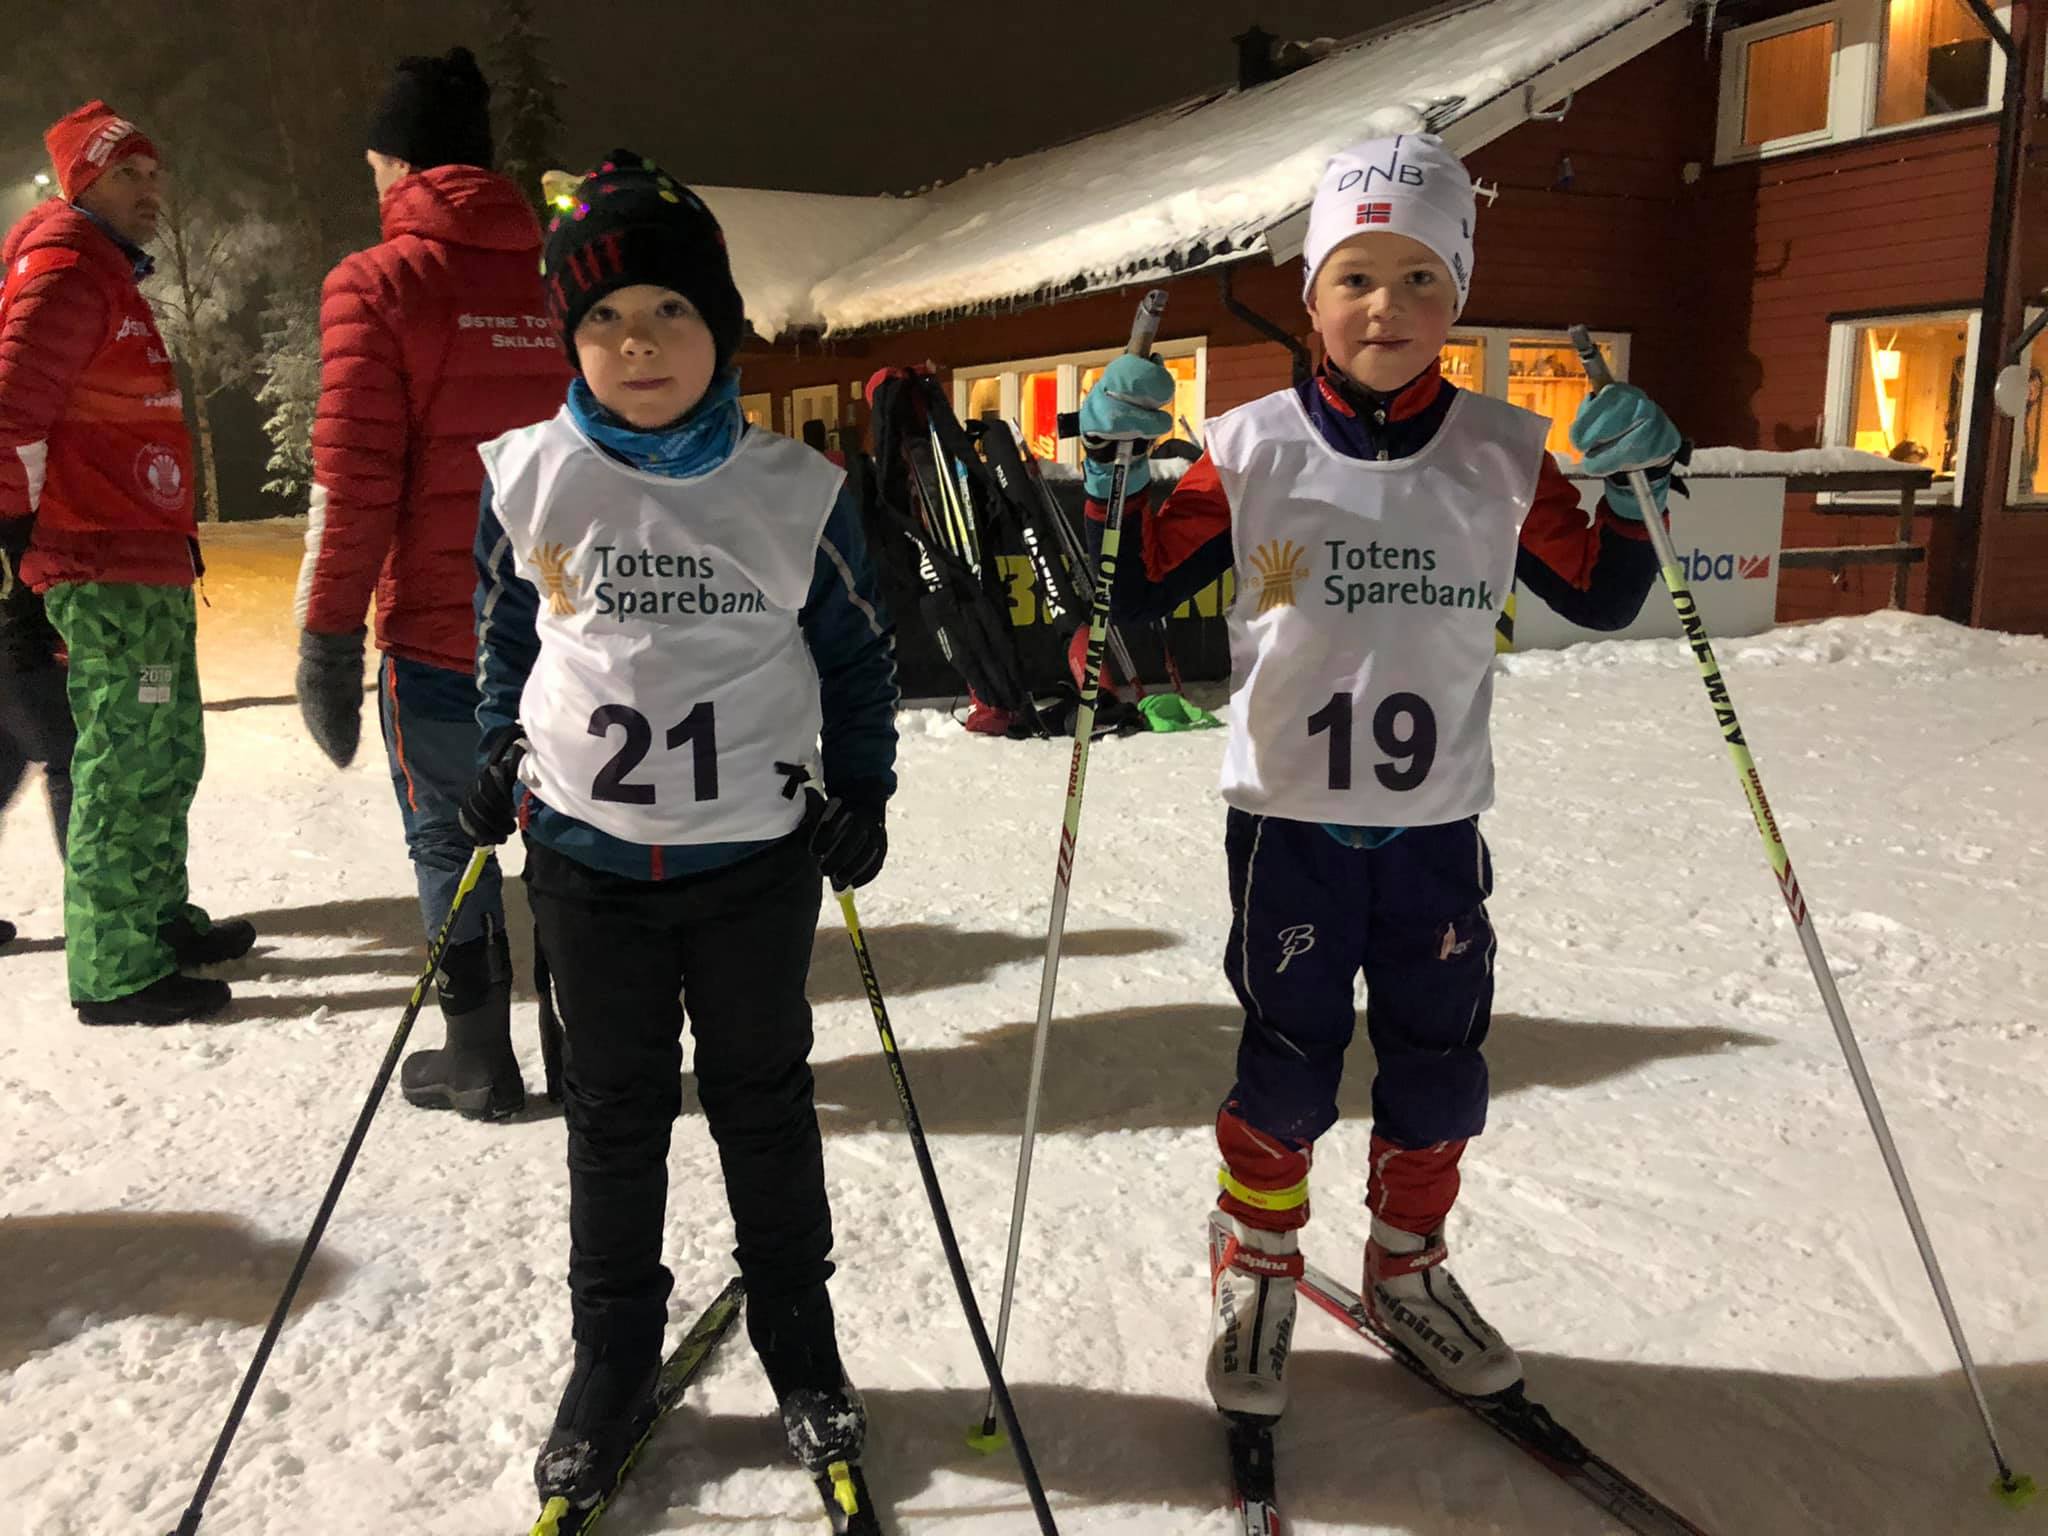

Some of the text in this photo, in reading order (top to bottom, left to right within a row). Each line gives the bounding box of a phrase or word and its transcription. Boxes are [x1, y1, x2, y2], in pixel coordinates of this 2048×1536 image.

[1337, 135, 1424, 192] DNB
[594, 545, 715, 579] Totens
[1324, 540, 1437, 571] Totens
[595, 582, 768, 622] Sparebank
[1324, 575, 1493, 613] Sparebank
[1671, 590, 1747, 747] ONE WAY
[586, 701, 720, 805] 21
[1068, 741, 1083, 798] STORM
[1307, 691, 1438, 792] 19
[1748, 767, 1782, 844] DIAMOND
[1233, 1252, 1289, 1272] alpina
[1220, 1281, 1242, 1374] alpina
[1375, 1283, 1464, 1365] alpina
